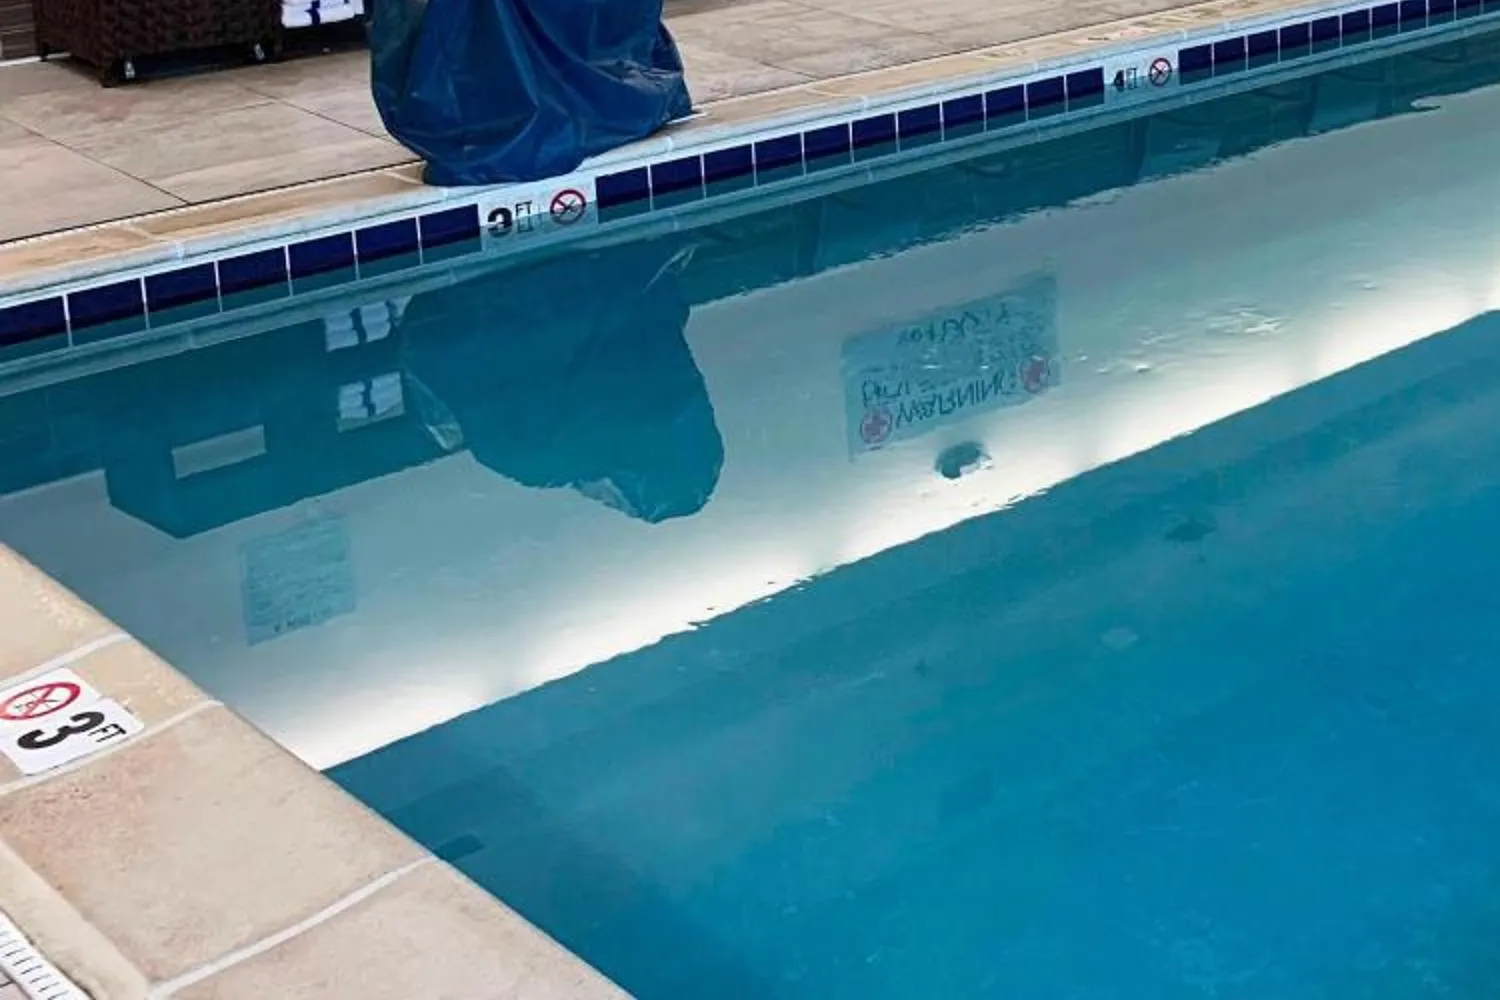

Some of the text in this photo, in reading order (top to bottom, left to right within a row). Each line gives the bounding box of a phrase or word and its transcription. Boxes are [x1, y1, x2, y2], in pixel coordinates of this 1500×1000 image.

[487, 207, 512, 233] 3
[17, 711, 127, 750] 3 FT
